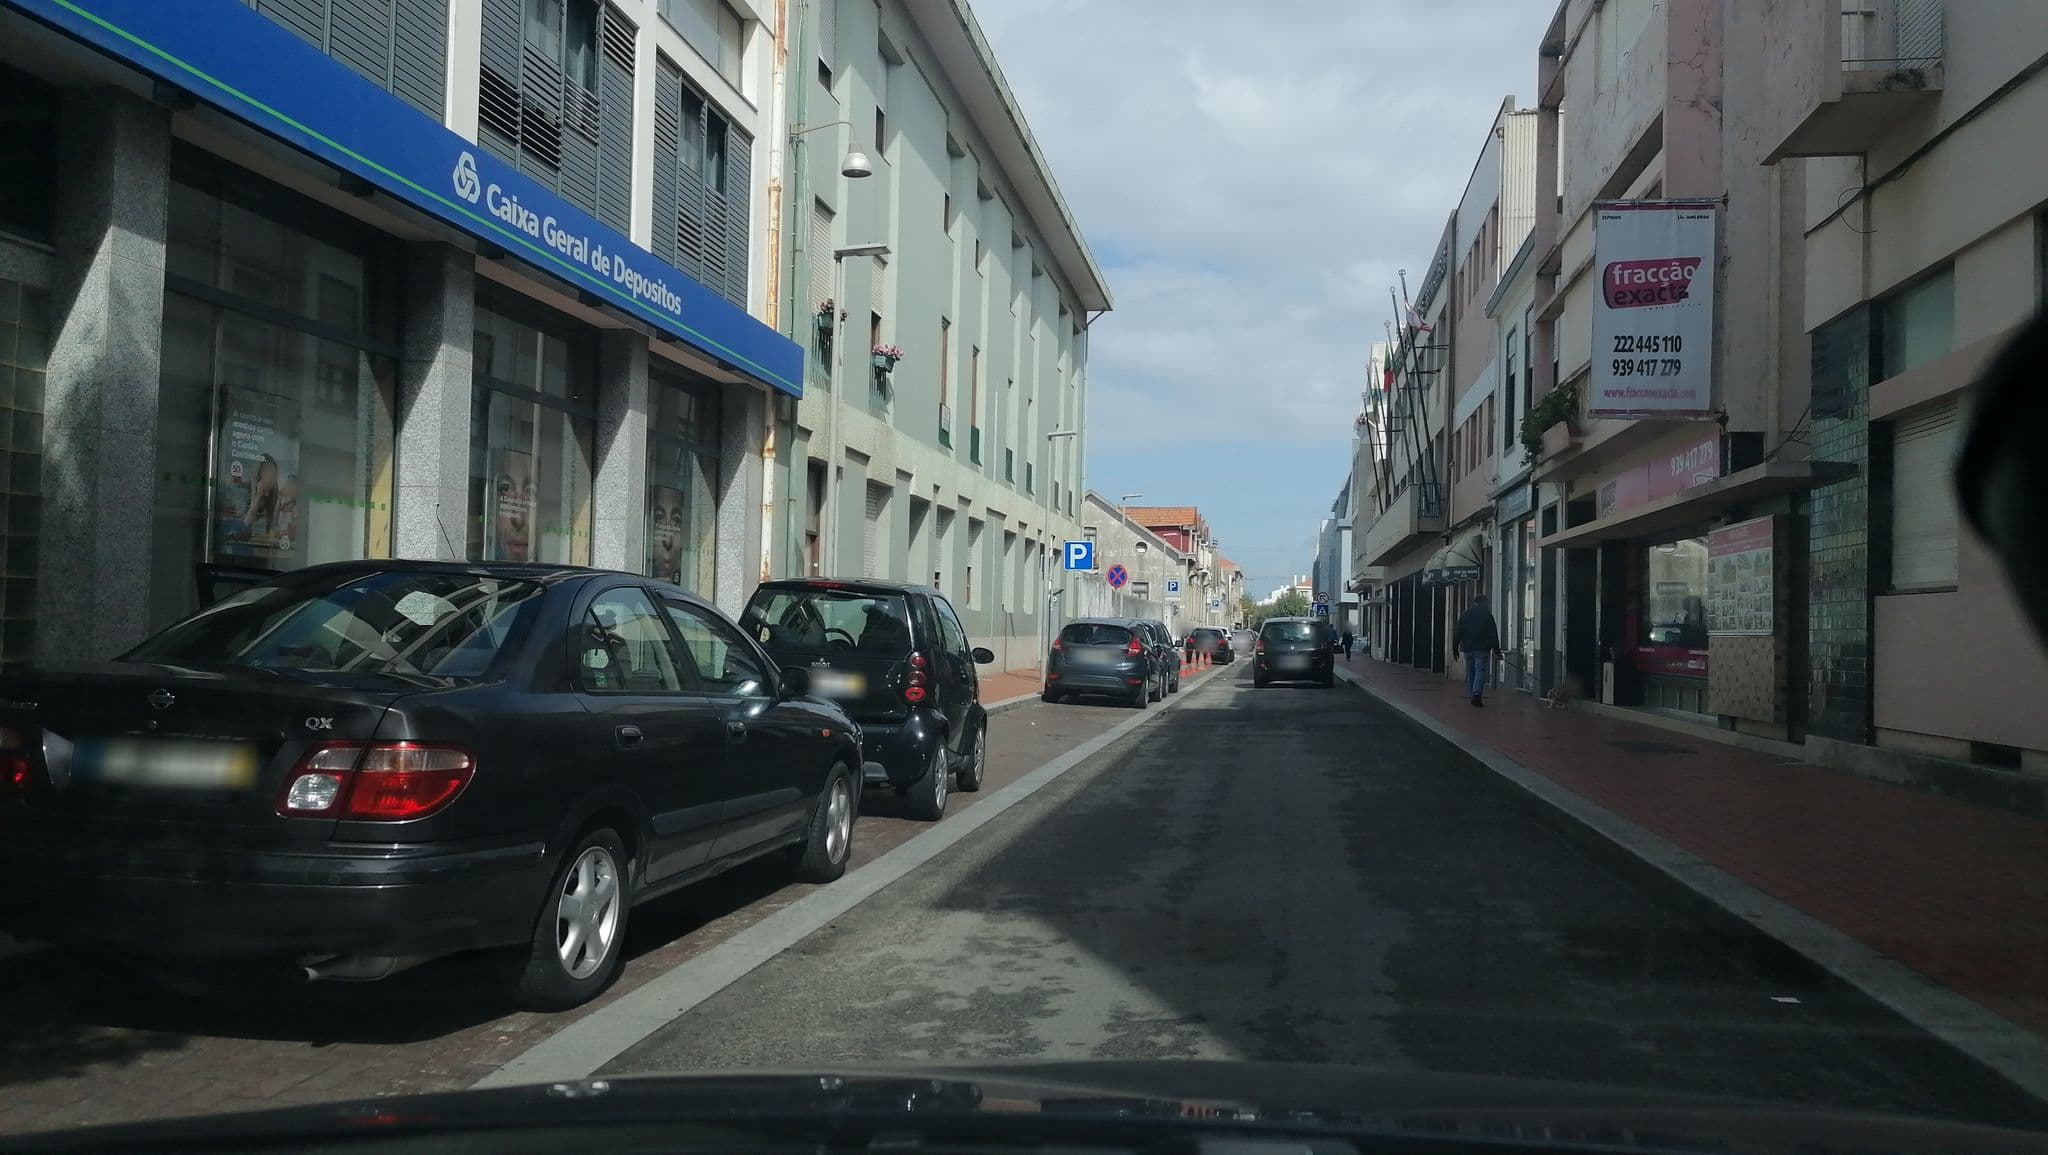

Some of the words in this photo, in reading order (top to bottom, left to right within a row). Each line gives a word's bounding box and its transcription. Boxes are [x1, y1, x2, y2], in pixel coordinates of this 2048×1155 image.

[486, 183, 539, 238] Caixa
[542, 216, 589, 265] Geral
[591, 244, 610, 277] de
[613, 254, 682, 316] Depositos
[1612, 261, 1696, 287] fracção
[1613, 335, 1634, 353] 222
[1636, 335, 1660, 353] 445
[1662, 335, 1682, 353] 110
[1612, 359, 1634, 377] 939
[1636, 359, 1658, 377] 417
[1670, 453, 1685, 476] 939
[1069, 544, 1088, 569] P
[305, 717, 334, 731] QX
